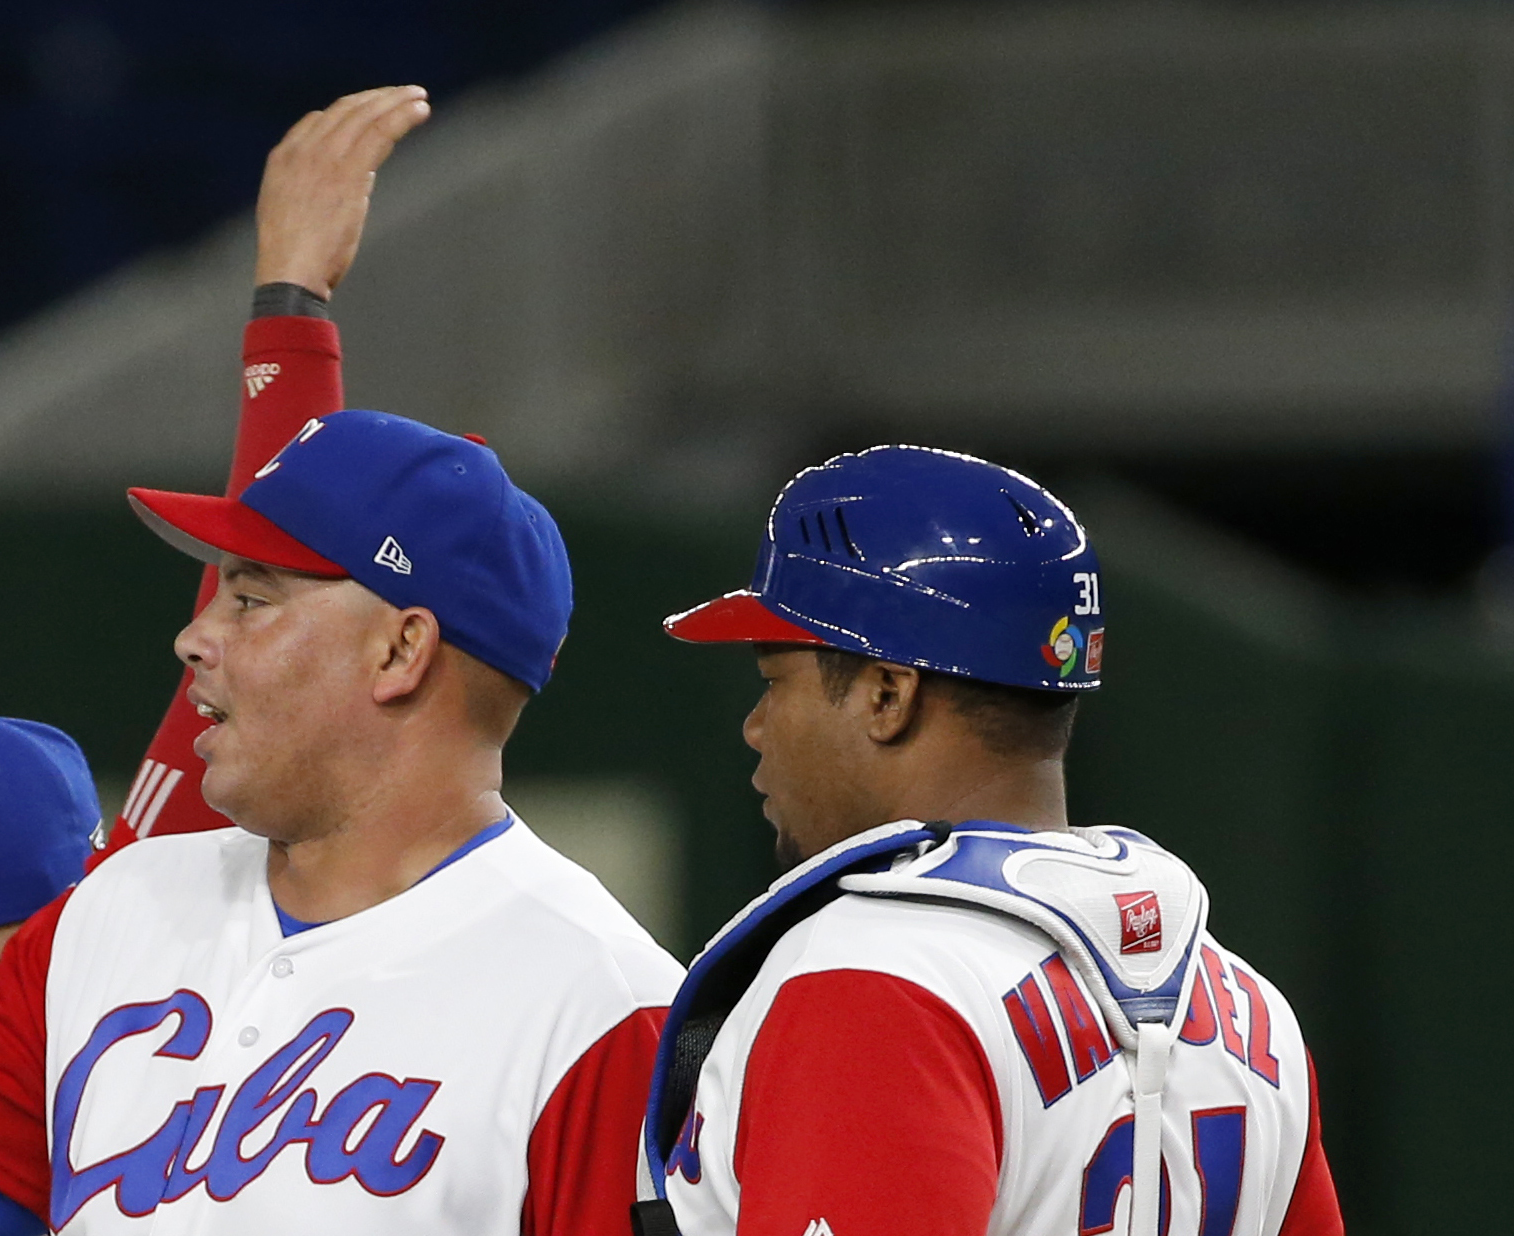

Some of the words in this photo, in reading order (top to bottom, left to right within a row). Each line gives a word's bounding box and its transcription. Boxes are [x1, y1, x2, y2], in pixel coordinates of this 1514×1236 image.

[1072, 572, 1101, 616] 31
[1001, 942, 1280, 1110] VAUEZ
[48, 988, 446, 1236] Cuba
